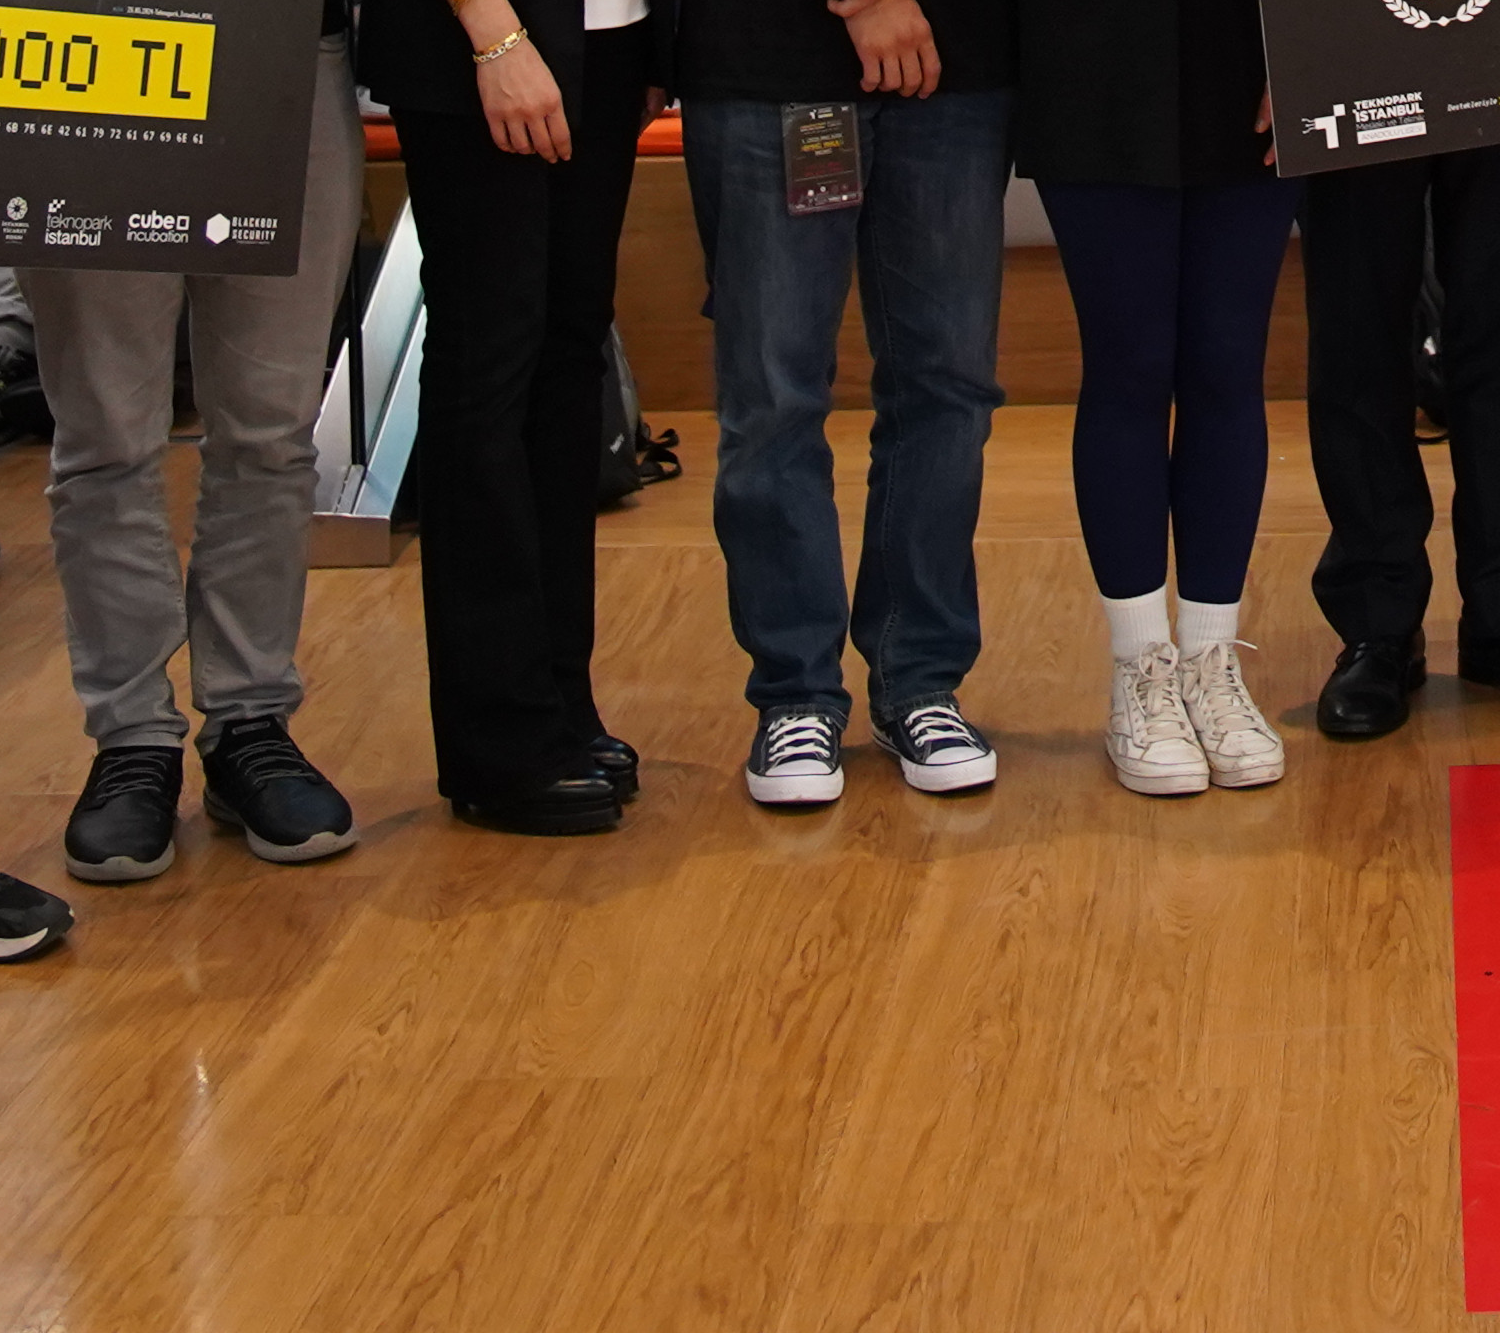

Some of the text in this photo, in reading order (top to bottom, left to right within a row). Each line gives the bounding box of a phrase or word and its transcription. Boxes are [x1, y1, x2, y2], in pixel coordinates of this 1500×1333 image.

[131, 39, 192, 100] TL
[1353, 91, 1423, 111] TEKNOPARK
[1352, 103, 1425, 123] İSTANBUL
[47, 214, 113, 231] teknopark
[129, 210, 175, 230] cube
[232, 216, 278, 229] BLACKBOX
[45, 231, 101, 247] istanbul
[126, 228, 189, 244] incubation
[232, 228, 276, 241] SECURITY
